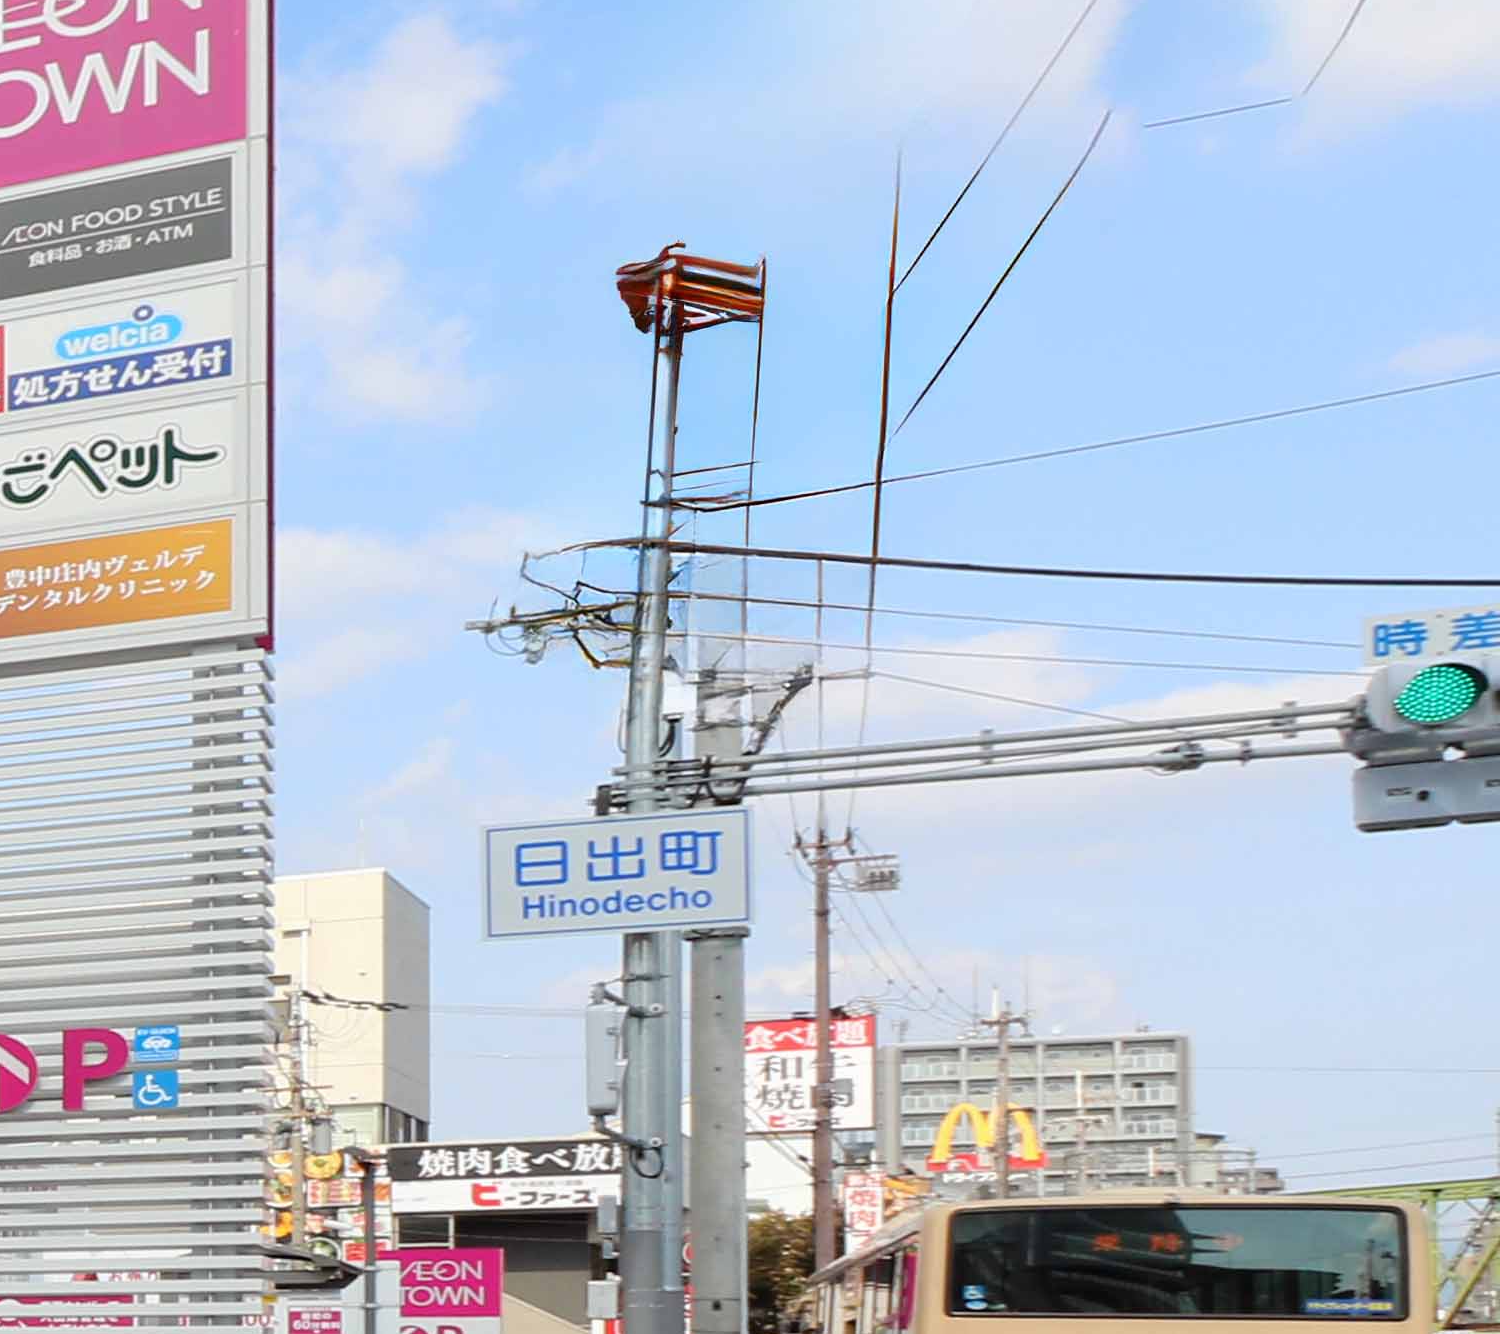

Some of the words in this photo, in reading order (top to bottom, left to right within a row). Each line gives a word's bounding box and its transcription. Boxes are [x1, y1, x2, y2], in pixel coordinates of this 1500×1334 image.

[71, 204, 143, 233] FOOD
[150, 187, 222, 218] STYLE
[64, 306, 171, 357] welcia
[14, 347, 227, 406] 処方せん受付
[4, 544, 206, 591] 豊中庄内ヴェルデ
[515, 830, 724, 887] 日出町
[521, 887, 713, 921] Hinodecho
[62, 1027, 130, 1112] P
[401, 1285, 485, 1307] TOWN
